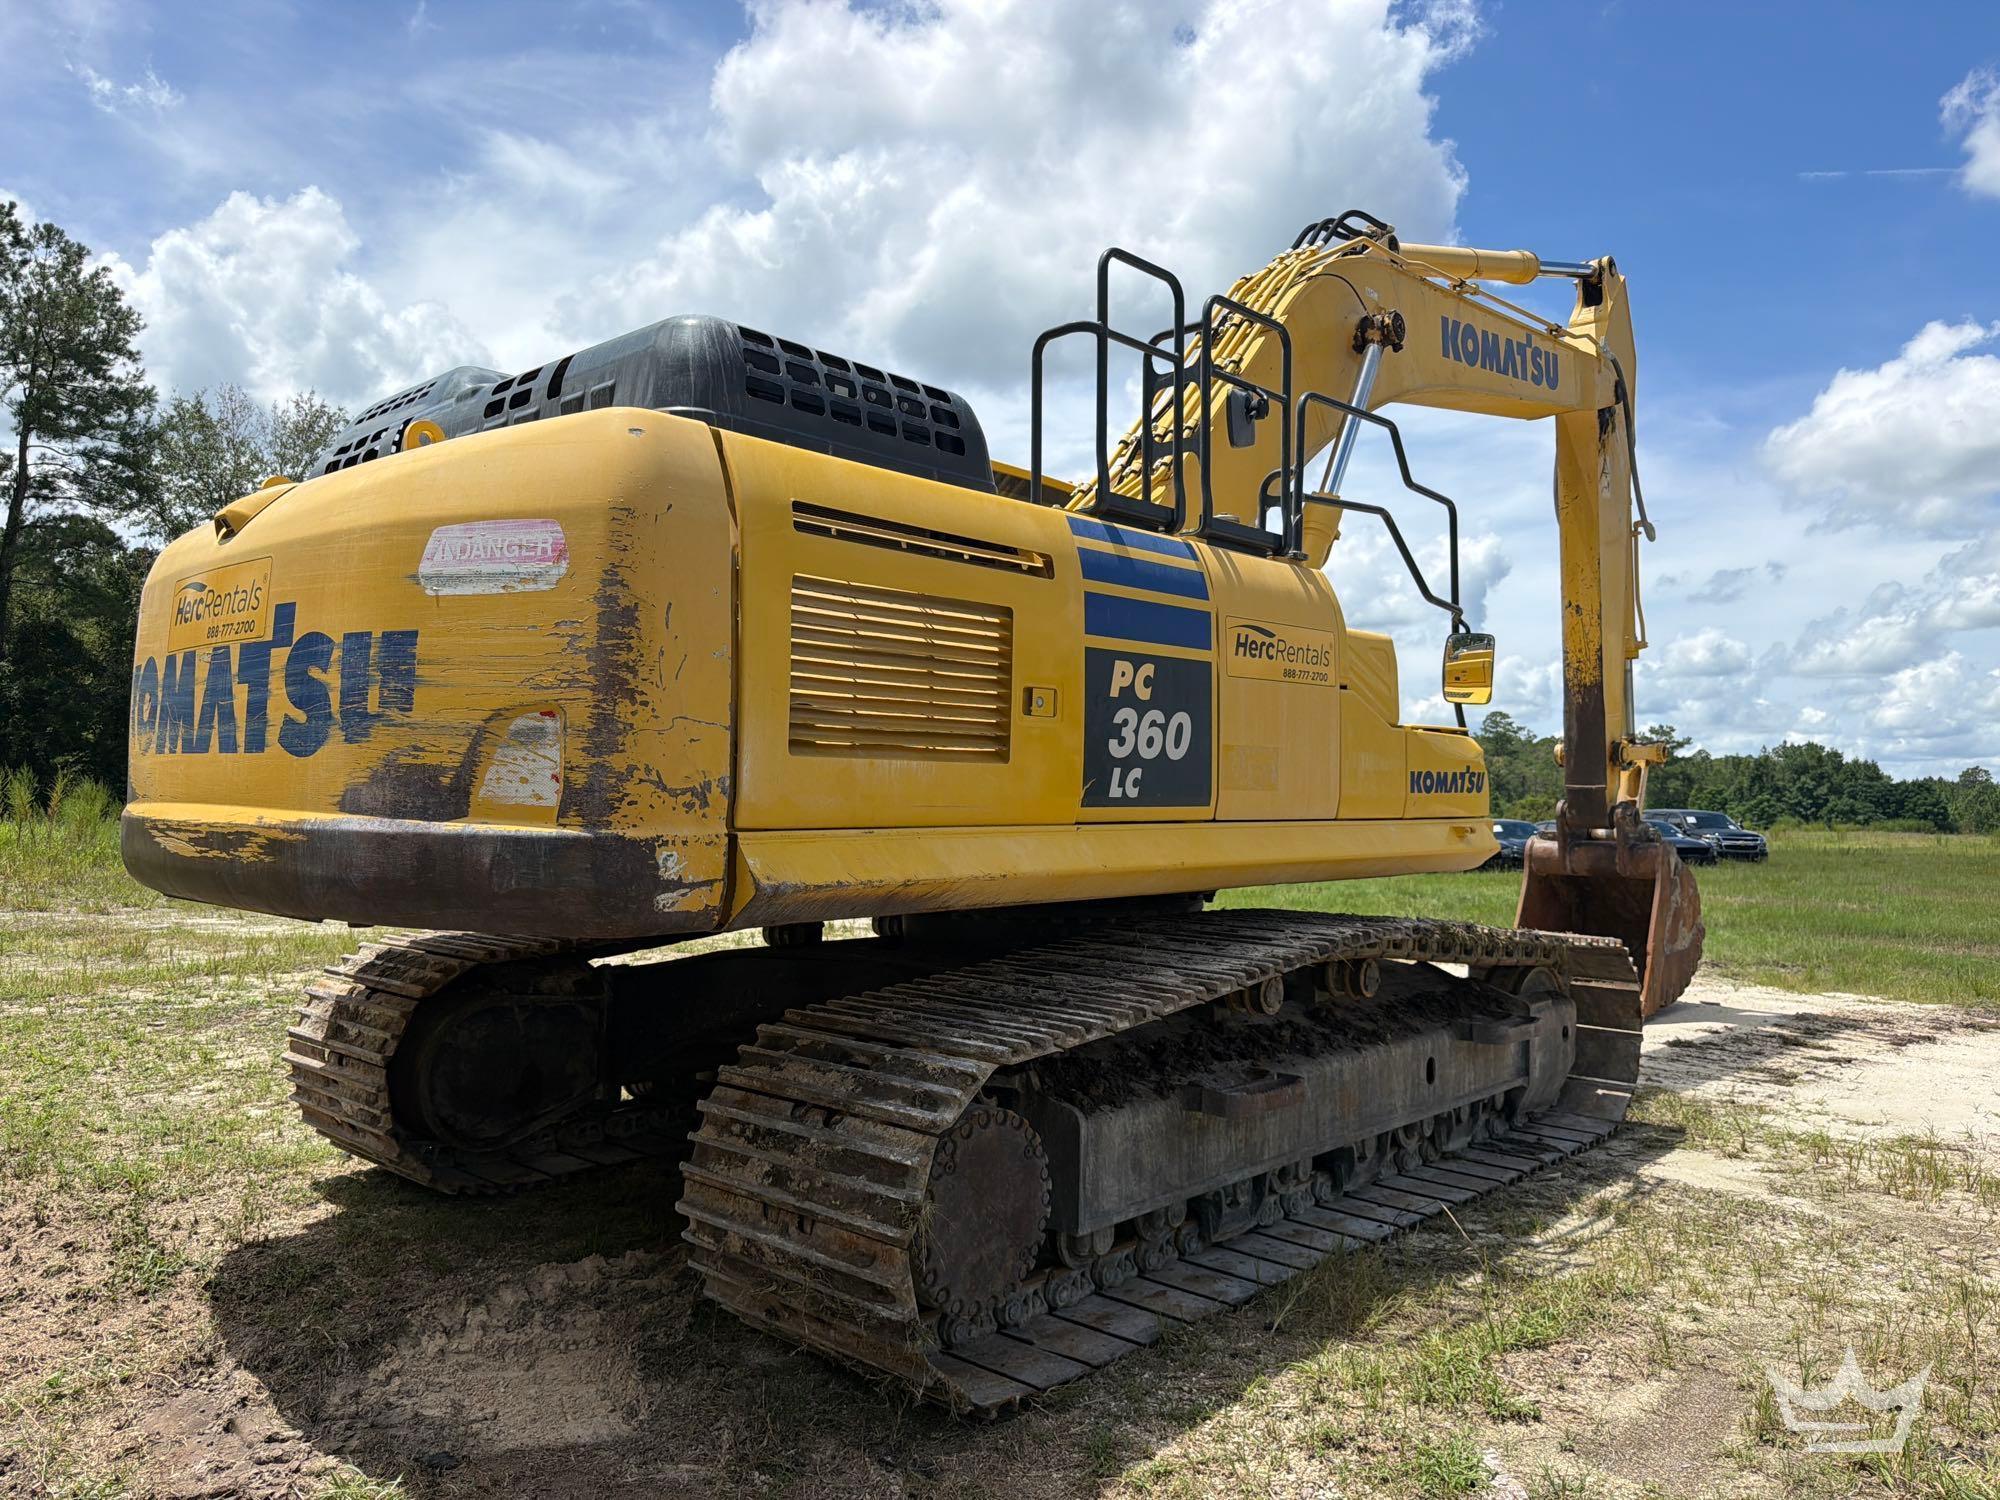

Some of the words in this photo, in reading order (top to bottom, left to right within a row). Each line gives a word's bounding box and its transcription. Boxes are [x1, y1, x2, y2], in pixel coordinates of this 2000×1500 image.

[1441, 315, 1559, 390] KOMATSU
[456, 535, 554, 559] DANGER
[206, 619, 255, 639] 888-777-2700
[1235, 633, 1330, 667] HercRentals
[1109, 660, 1155, 700] PC
[1283, 668, 1328, 682] 888-777-2700
[1108, 707, 1192, 760] 360
[1108, 767, 1142, 798] LC
[1410, 766, 1485, 794] KOMATSU
